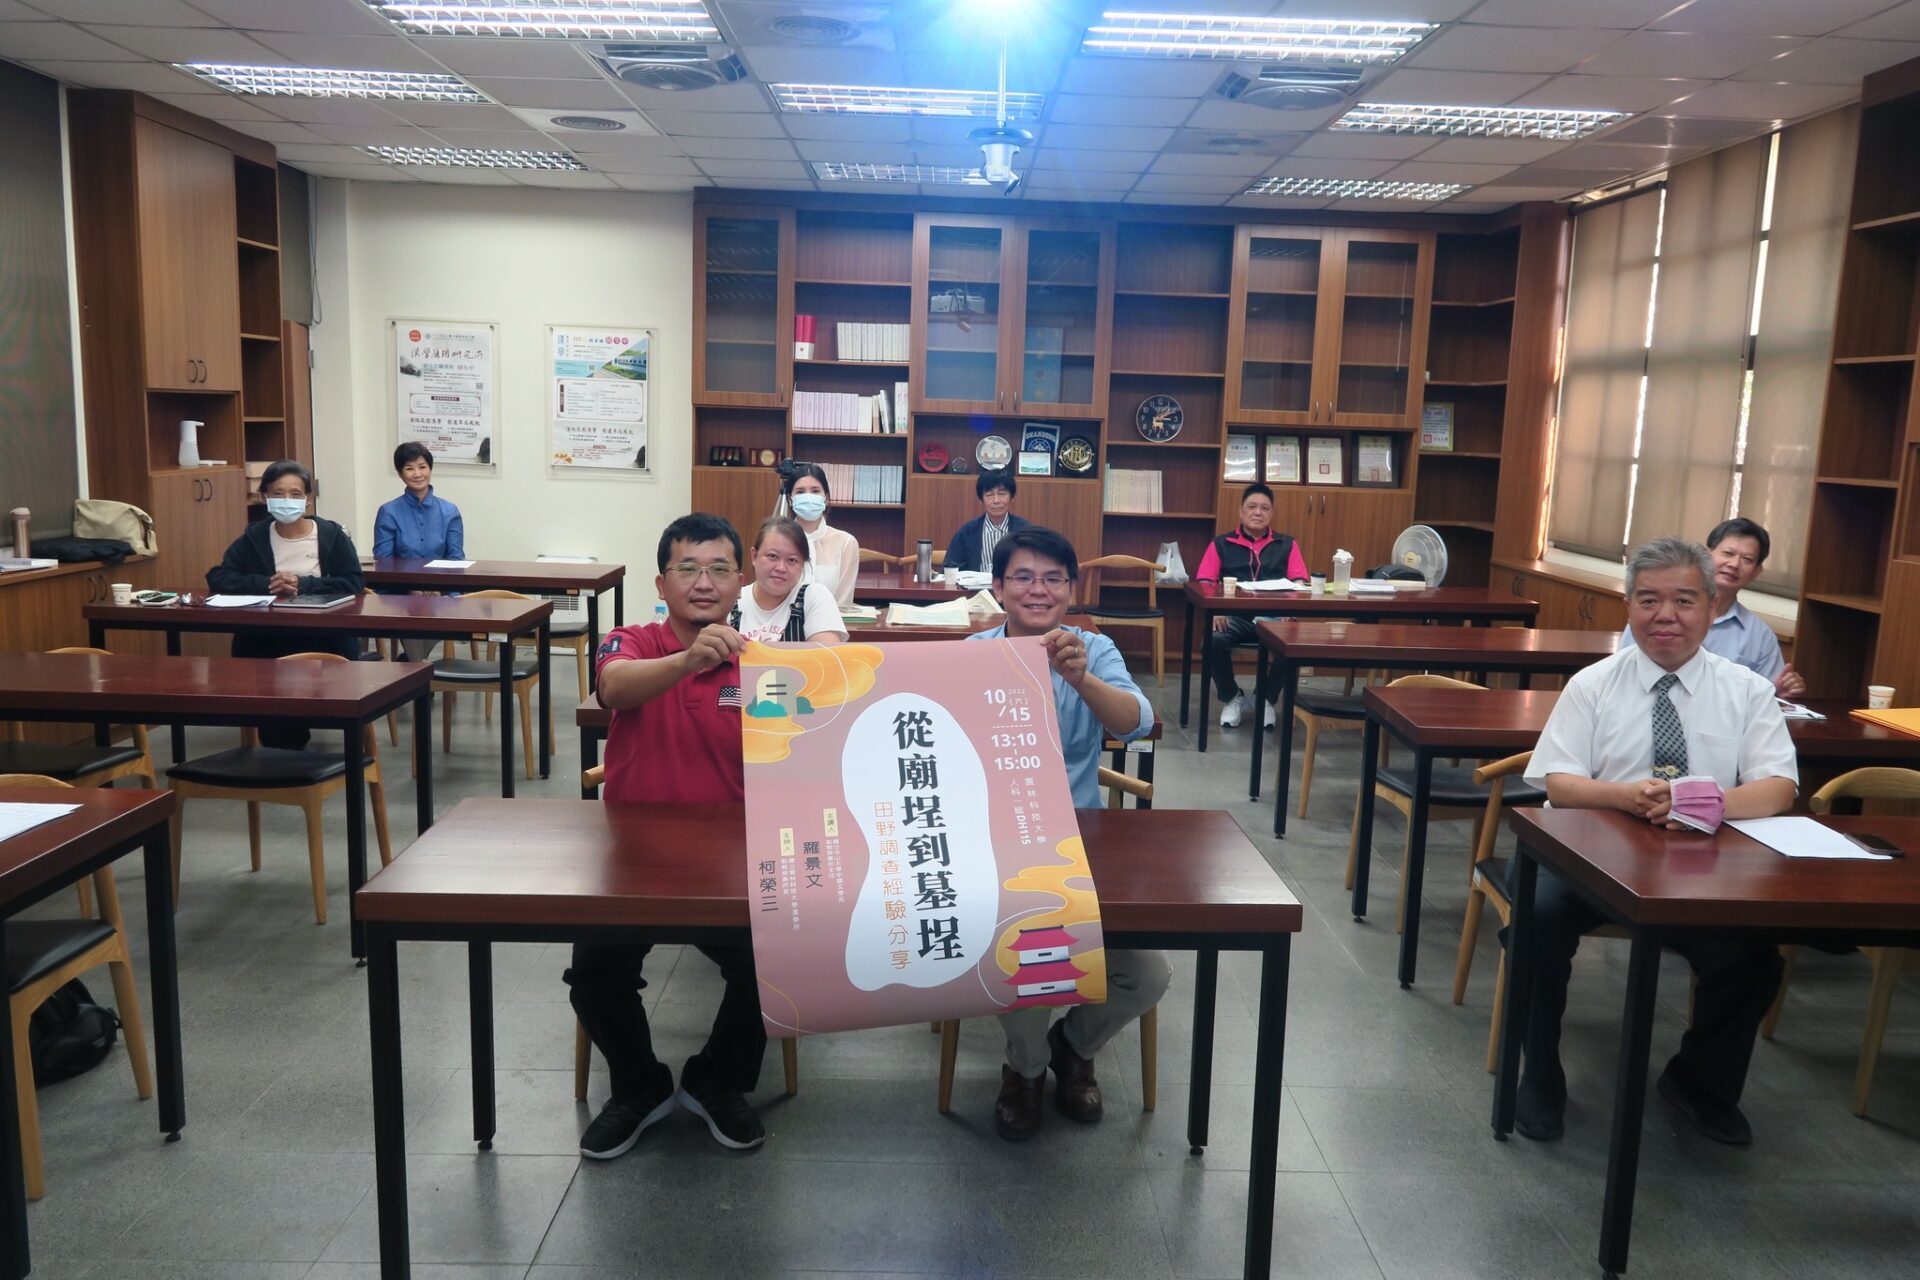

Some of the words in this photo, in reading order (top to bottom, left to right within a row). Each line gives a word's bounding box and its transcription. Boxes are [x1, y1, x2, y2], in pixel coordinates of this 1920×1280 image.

[984, 689, 1006, 705] 10
[991, 732, 1037, 748] 13:10
[994, 755, 1041, 771] 15:00
[893, 710, 965, 961] 從廟埕到墓埕
[1024, 777, 1046, 844] 雲林科技大學
[759, 860, 779, 912] 柯榮三
[803, 841, 823, 889] 羅景文
[874, 801, 911, 970] 田野調查經驗分享
